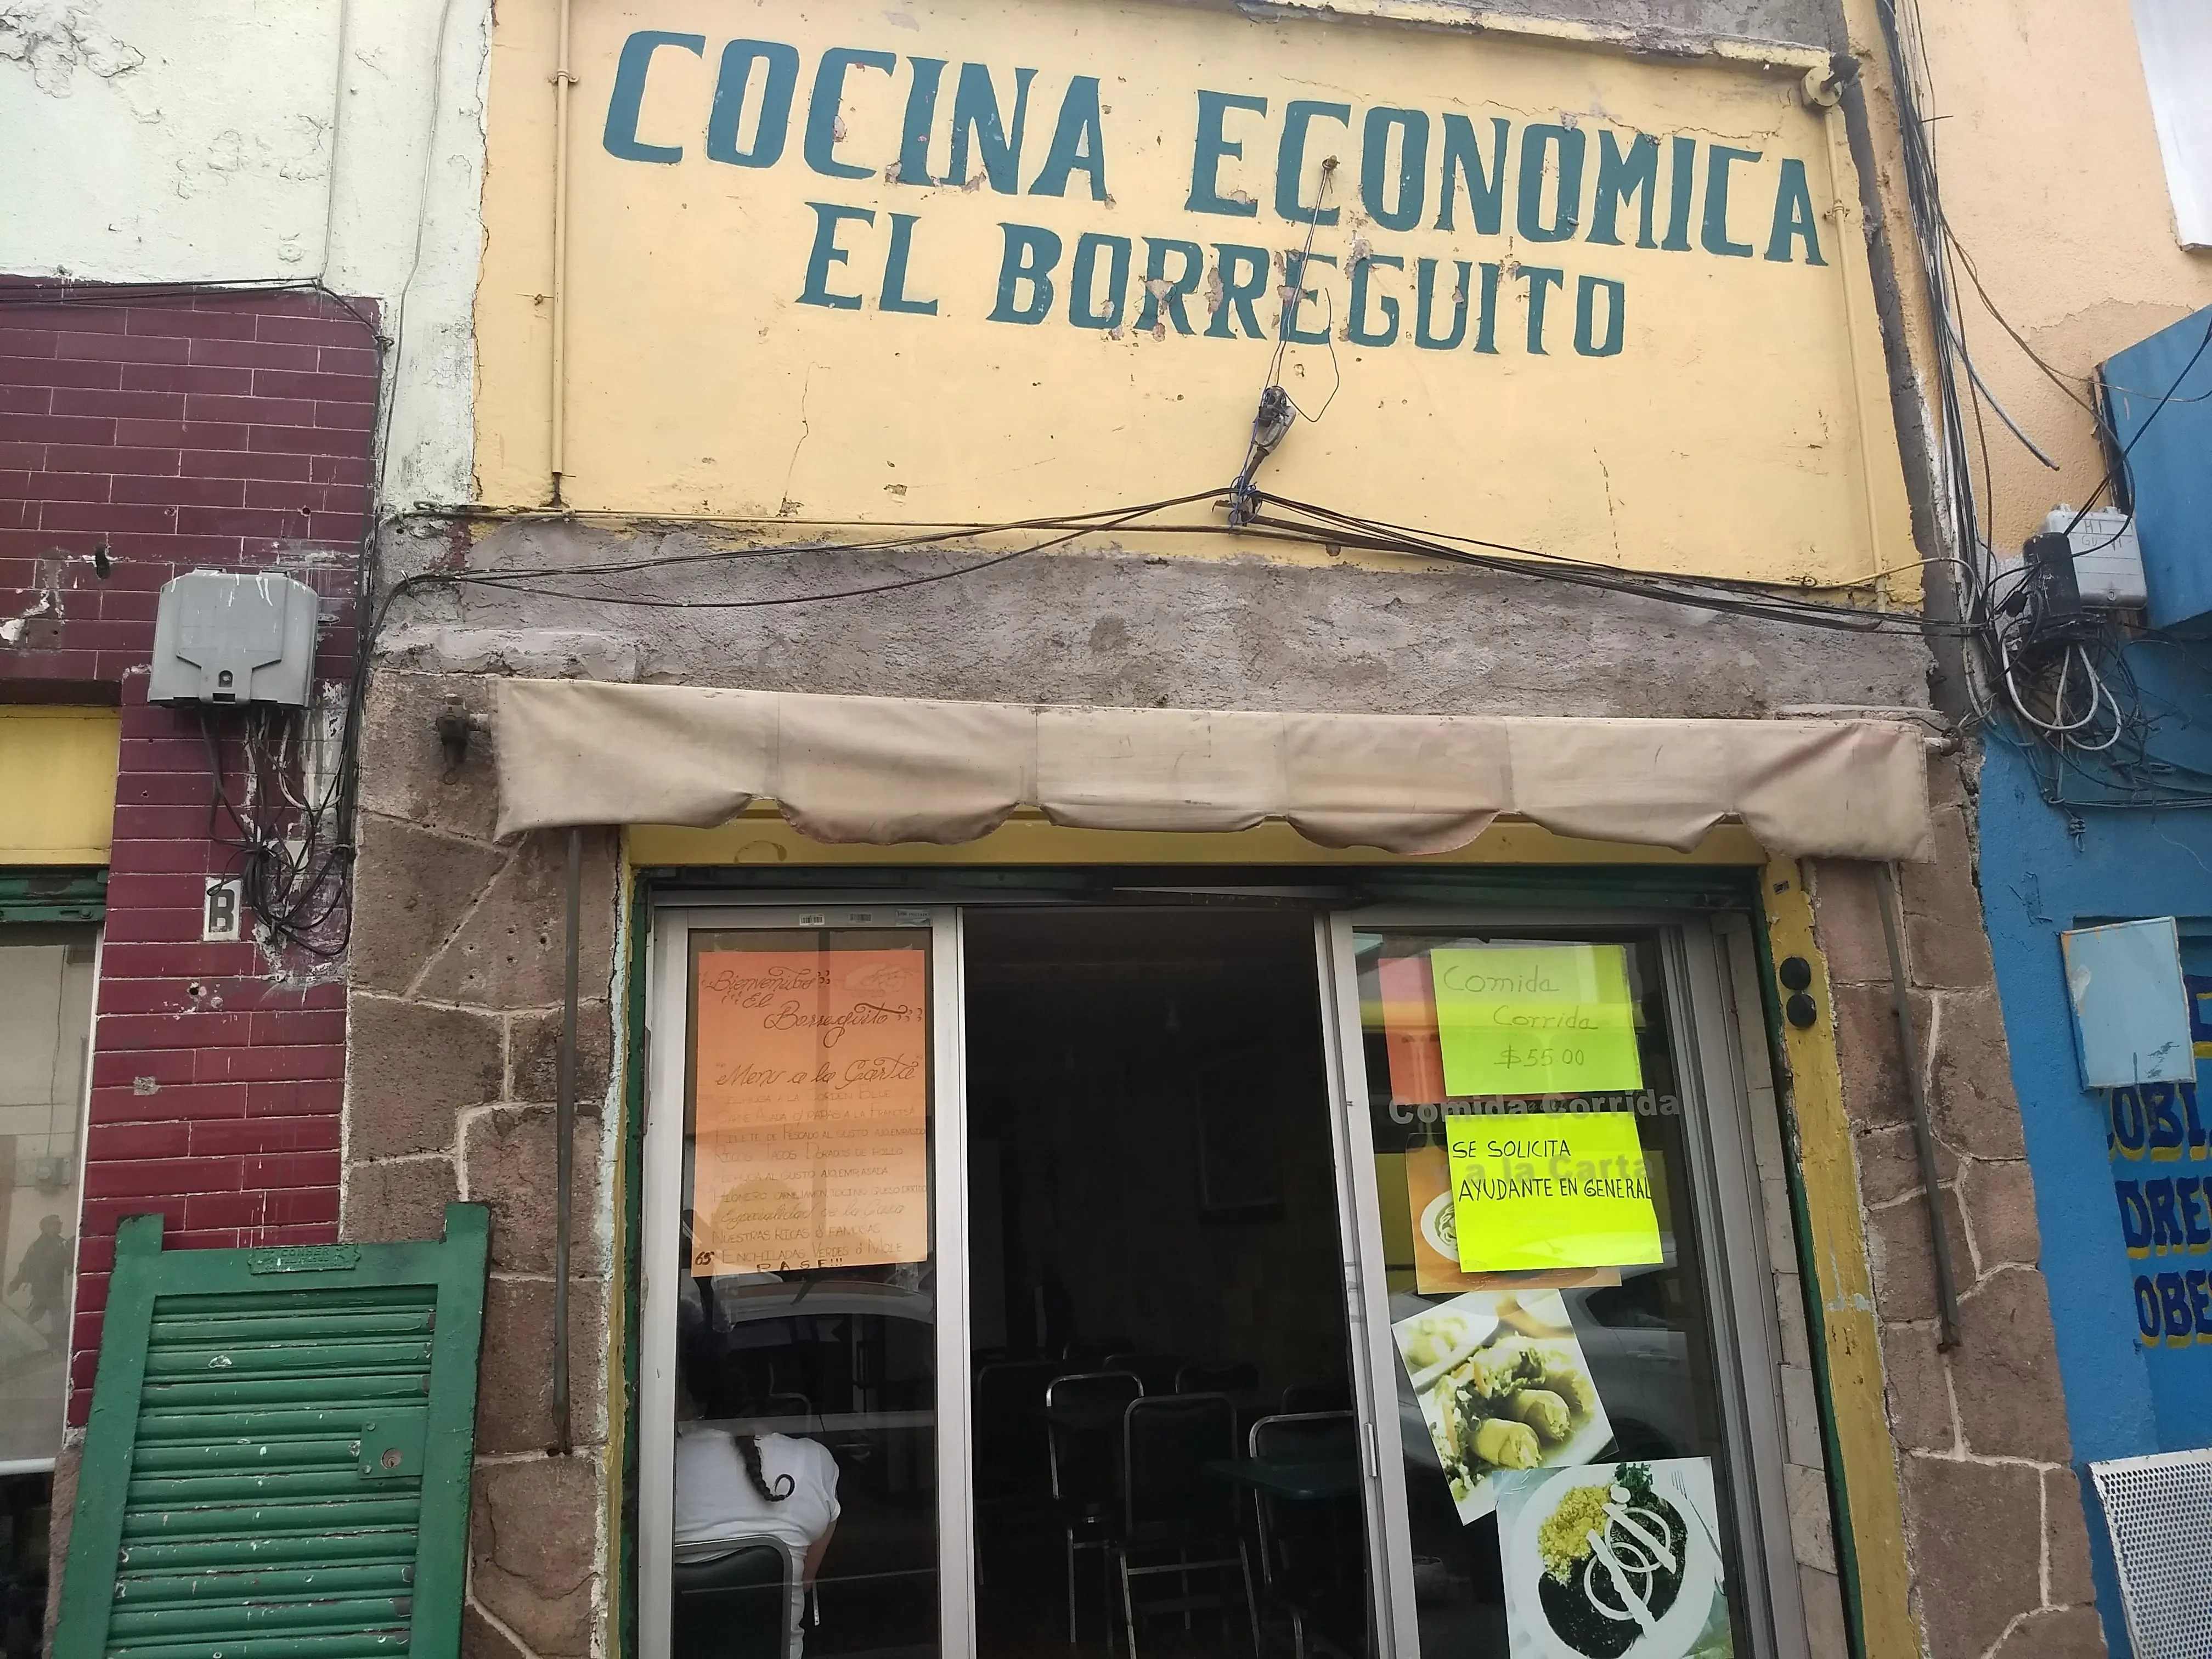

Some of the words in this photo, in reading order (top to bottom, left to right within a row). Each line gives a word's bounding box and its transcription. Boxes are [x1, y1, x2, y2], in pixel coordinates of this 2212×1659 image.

[603, 30, 1108, 202] COCINA
[1183, 89, 1829, 266] ECONOMICA
[795, 201, 938, 317] EL
[986, 222, 1625, 358] BORREGUITO
[208, 889, 235, 933] B
[1443, 965, 1560, 992] Comida
[1493, 1005, 1598, 1030] Corrida
[1494, 1044, 1584, 1069] $55.00
[811, 1062, 836, 1085] la
[806, 1109, 841, 1120] PAPAS
[854, 1110, 866, 1119] LA
[1389, 1093, 1530, 1124] Comida
[1542, 1089, 1681, 1120] Corrida
[783, 1123, 819, 1141] PESCADO
[821, 1130, 833, 1139] AL
[836, 1129, 869, 1138] GUSTO
[1452, 1141, 1477, 1158] SE
[1487, 1139, 1571, 1158] SOLICITA
[765, 1172, 778, 1181] AL
[781, 1170, 816, 1181] GUSTO
[1458, 1178, 1553, 1202] AYUDANTE
[1560, 1177, 1578, 1196] EN
[1584, 1177, 1652, 1199] GENERAL
[2114, 1176, 2212, 1256] DRE
[712, 1230, 771, 1245] NUESTRAS
[723, 1248, 806, 1264] ENCHILADAS
[812, 1240, 849, 1258] VERDES
[868, 1235, 903, 1255] MOLE
[2134, 1269, 2212, 1347] OBE
